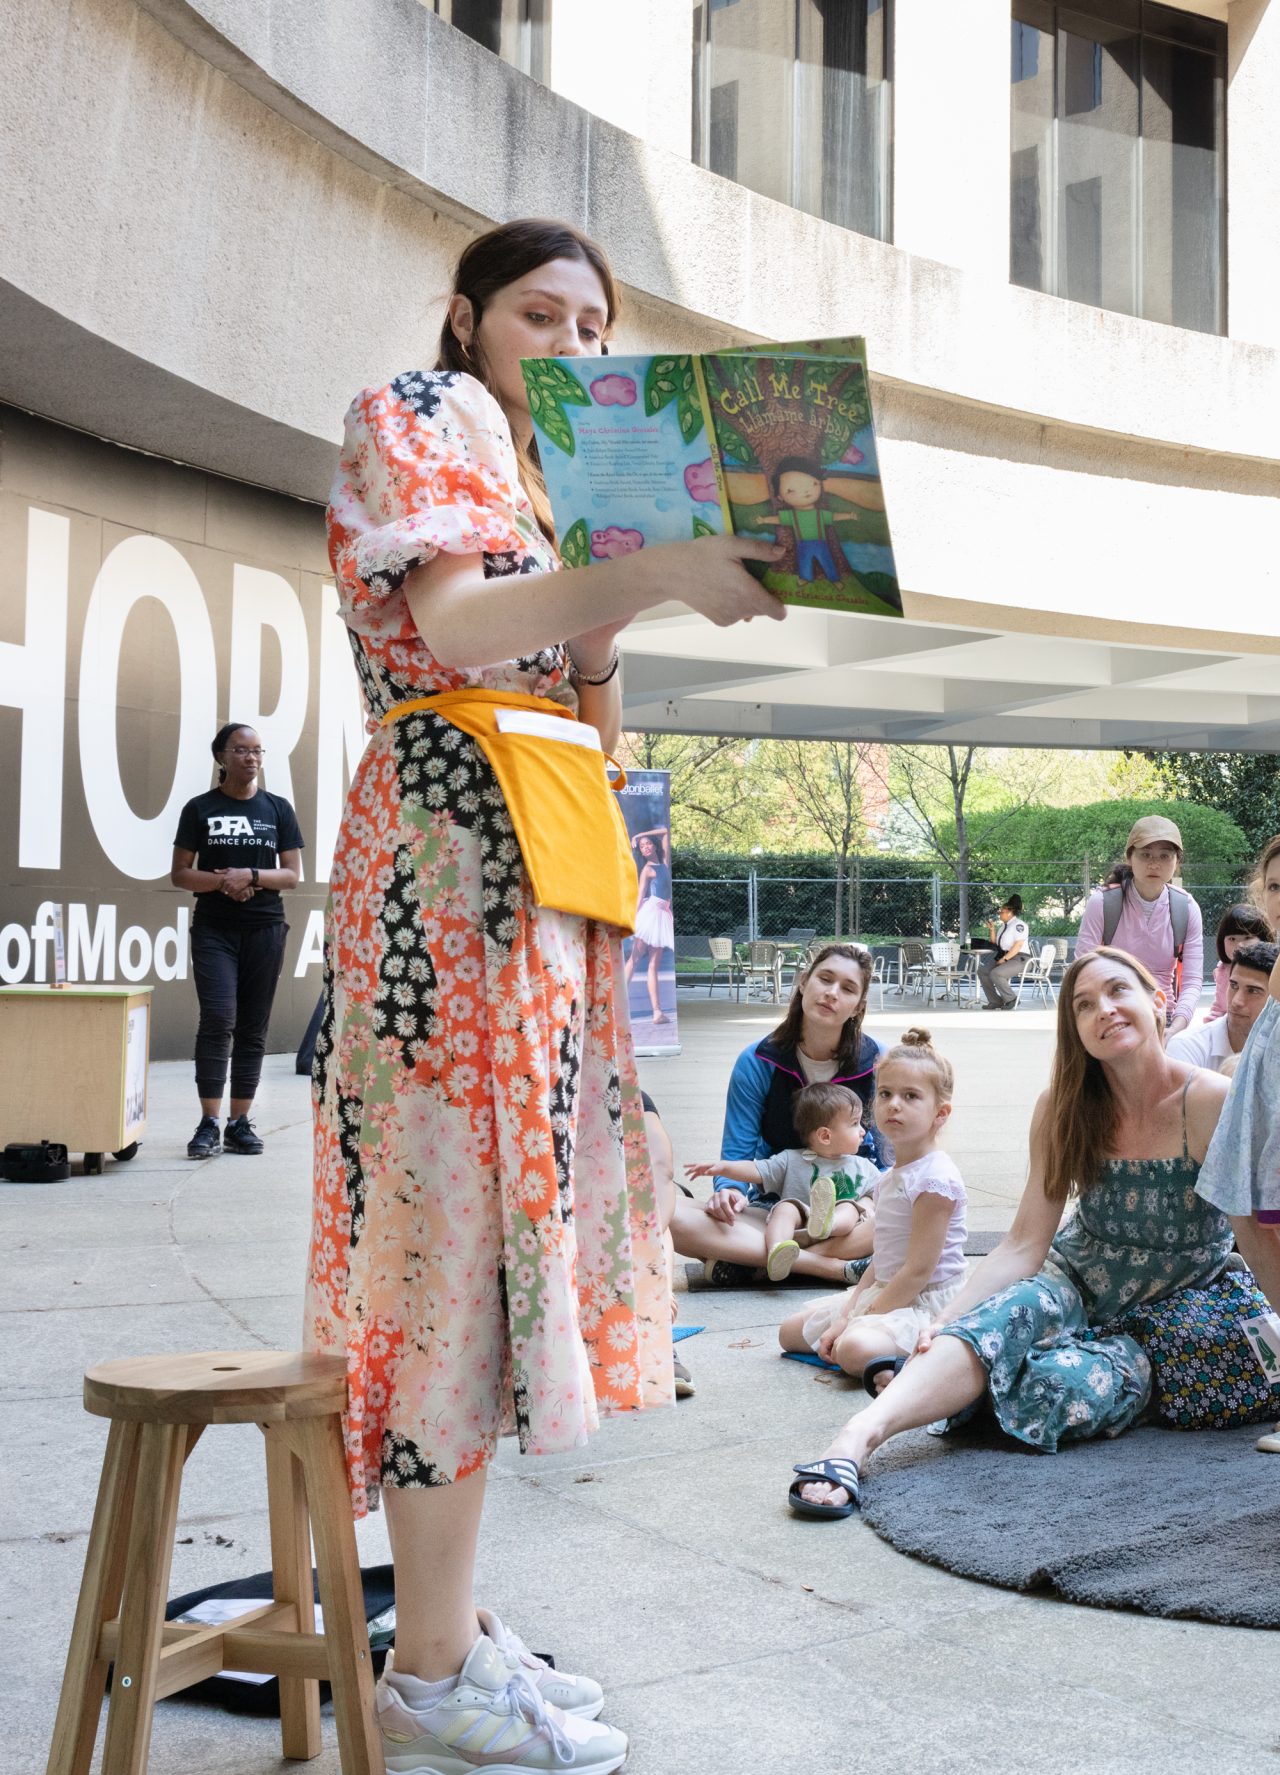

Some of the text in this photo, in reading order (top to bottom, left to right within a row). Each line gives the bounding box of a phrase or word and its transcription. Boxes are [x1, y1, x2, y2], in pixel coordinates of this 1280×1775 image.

[720, 372, 857, 422] Call Me Tree
[207, 815, 255, 837] DFA
[0, 900, 55, 983] of
